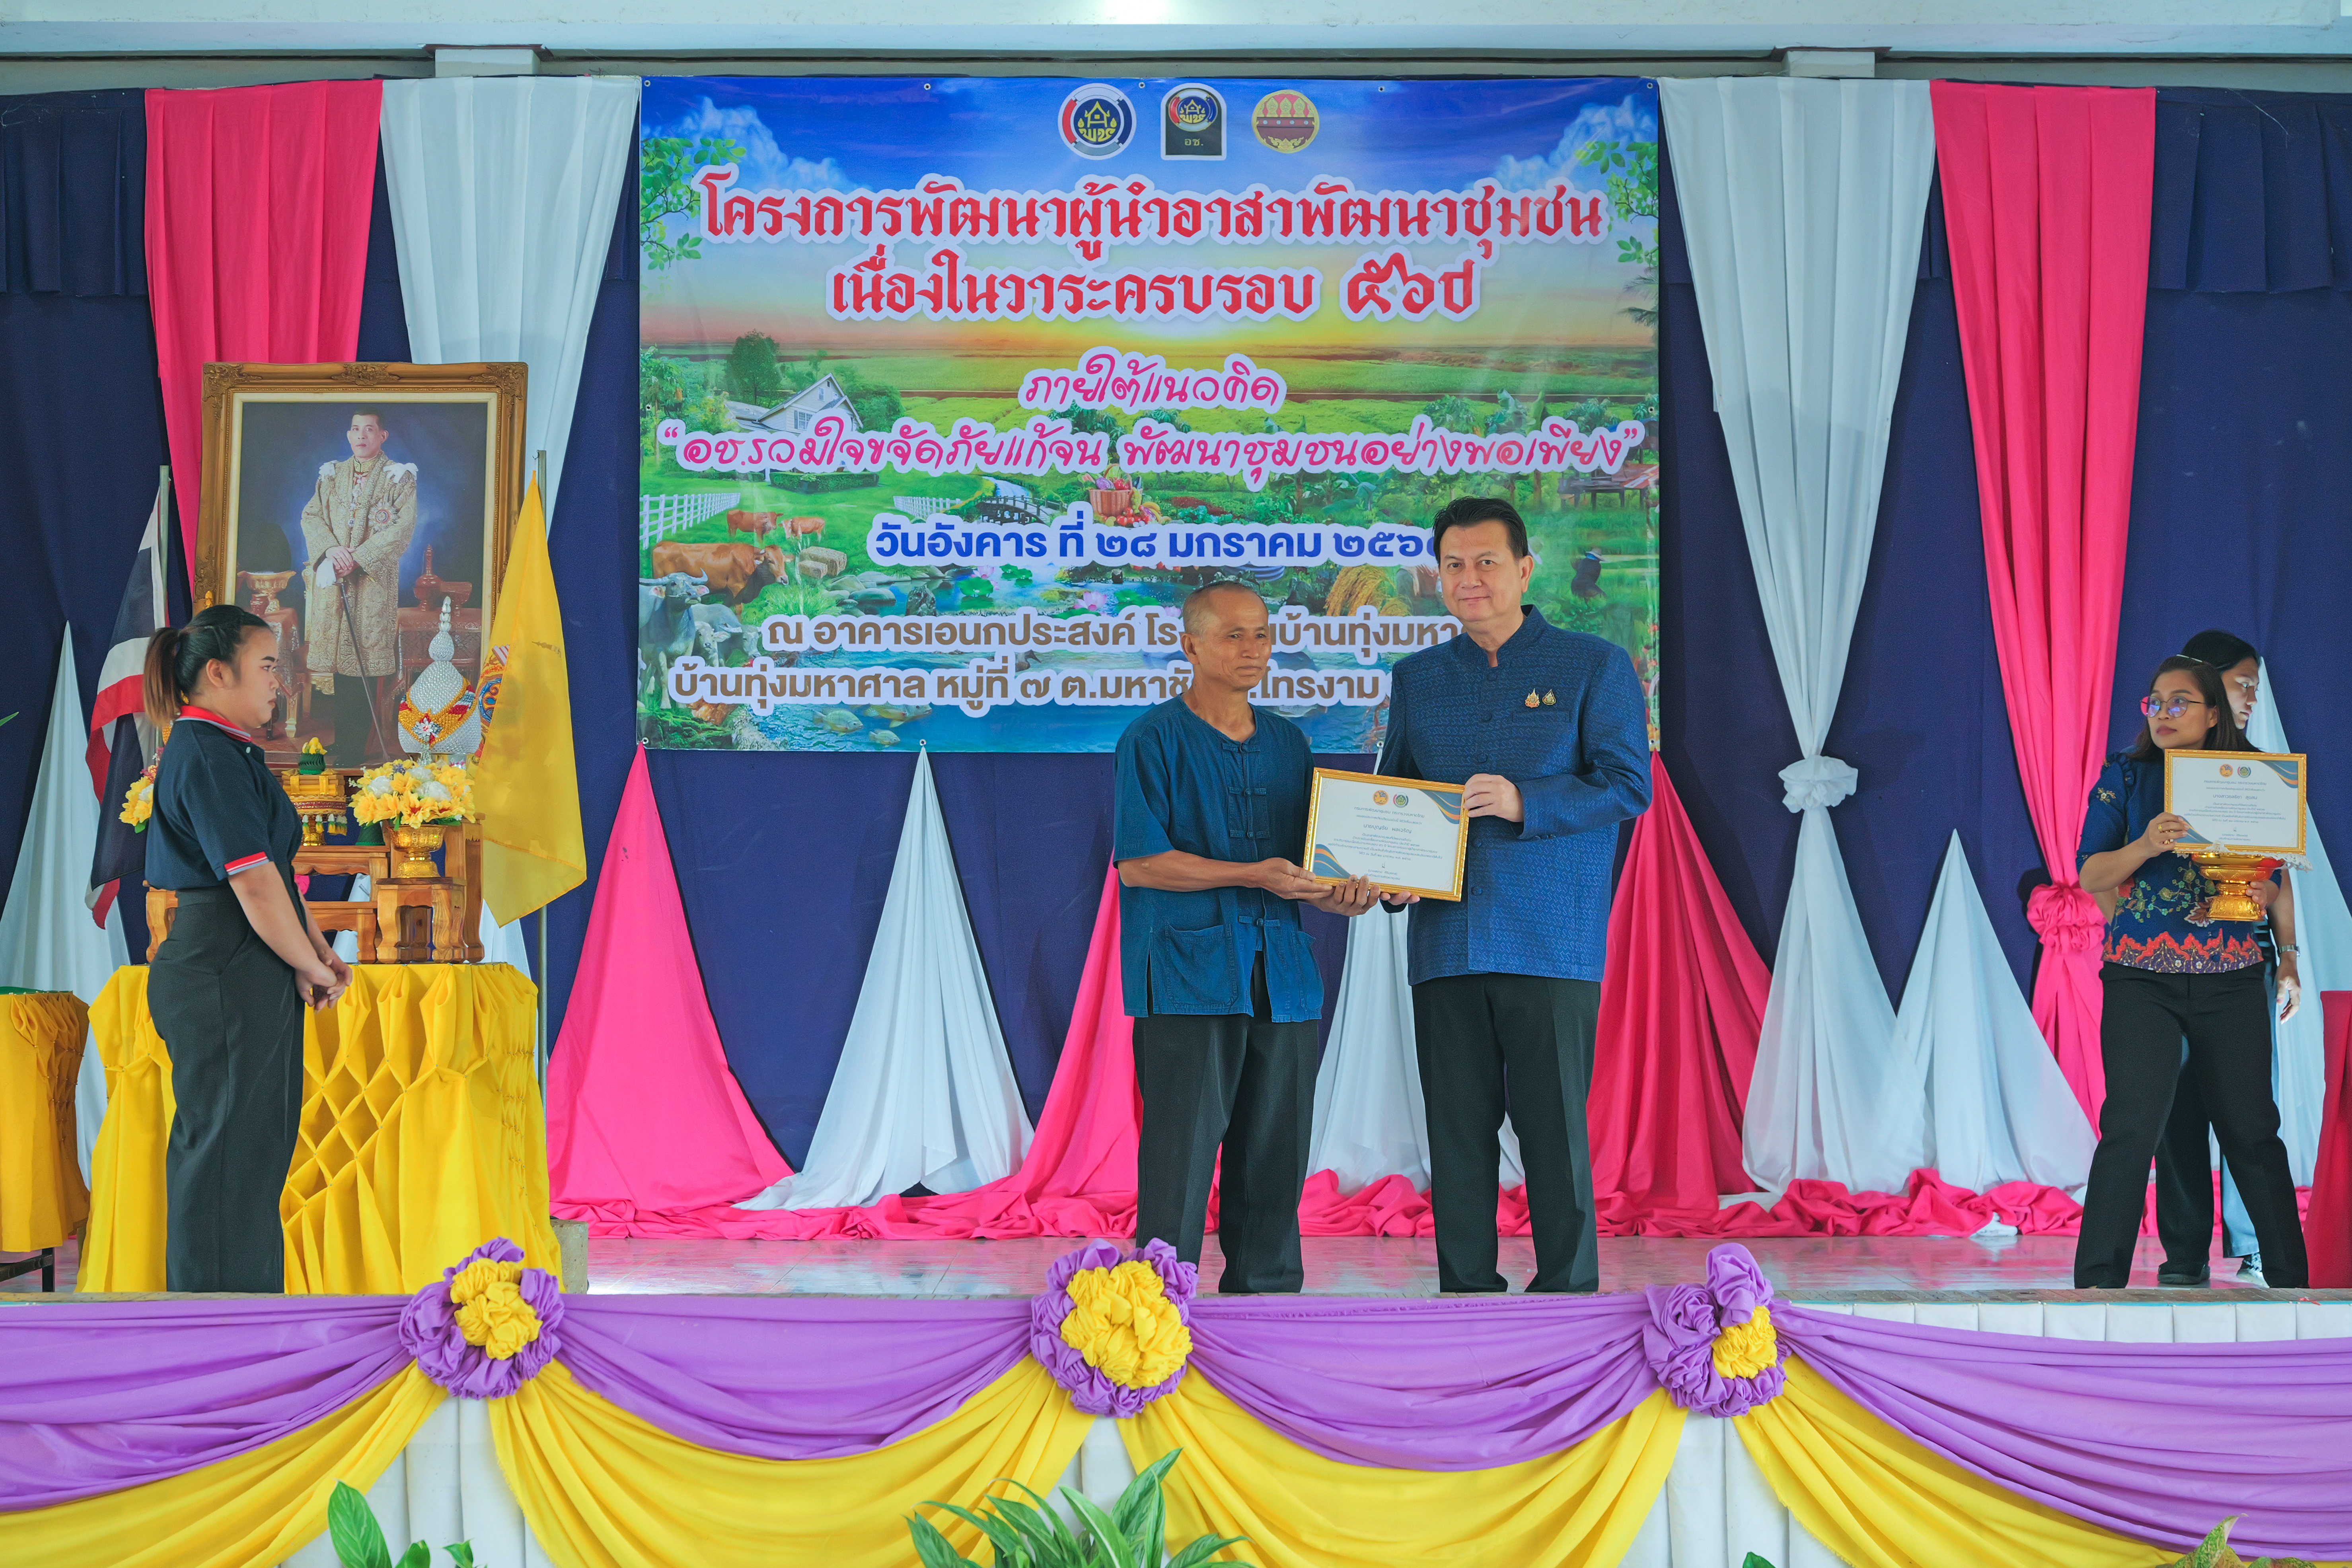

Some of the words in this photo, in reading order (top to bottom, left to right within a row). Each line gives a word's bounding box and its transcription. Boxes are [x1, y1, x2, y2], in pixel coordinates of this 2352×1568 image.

[699, 171, 1602, 261] โครงการพัฒนาผู้นำอาสาพัฒนาชุมชน
[833, 243, 1315, 314] เนื่องในวาระครบรอบ
[1026, 353, 1280, 407] ภายใต้แนวคิด
[876, 522, 1047, 557] วันอังคาร
[1059, 510, 1084, 557] ที่
[1096, 533, 1157, 557] ๒๘
[1169, 532, 1321, 557] มกราคม
[769, 622, 802, 644] ณ
[814, 612, 1135, 645] อาคารเอนกประสงค์
[676, 663, 925, 709] บ้านทุ่งมหาศาล
[937, 656, 1008, 709] หมู่ที่
[1021, 677, 1050, 698] ๗
[1061, 667, 1192, 698] ต.มหาชั
